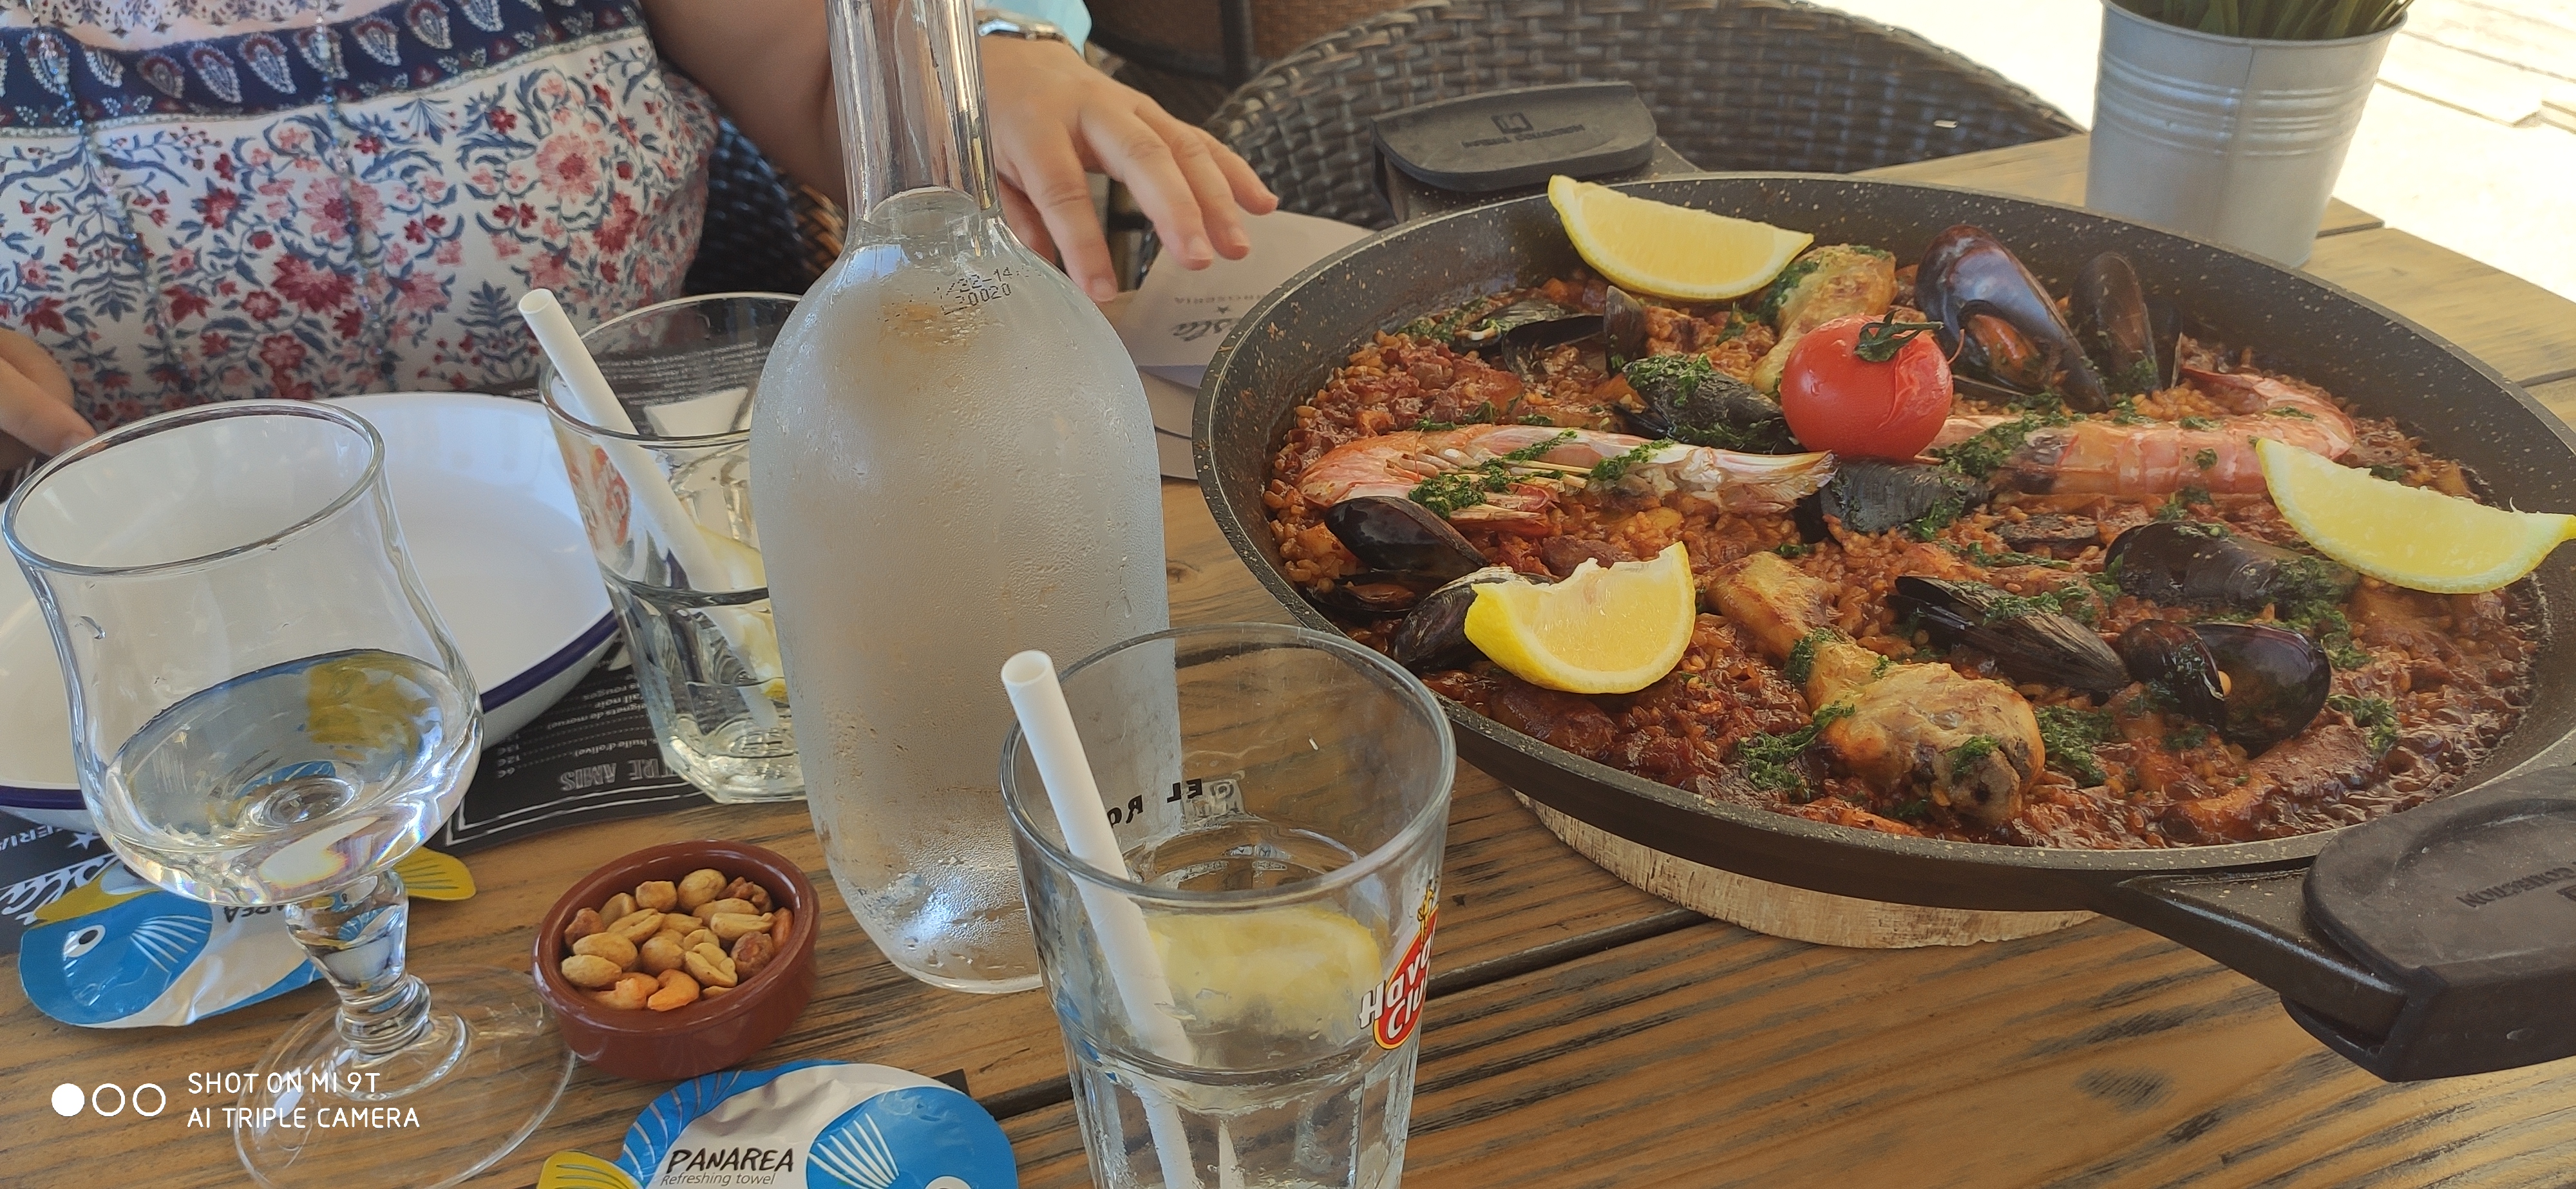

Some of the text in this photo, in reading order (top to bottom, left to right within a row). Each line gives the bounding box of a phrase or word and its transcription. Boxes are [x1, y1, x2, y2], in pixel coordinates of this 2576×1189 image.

[559, 758, 679, 791] TRE AMIS
[1358, 932, 1433, 1029] Hava
[1387, 969, 1428, 1040] Clu
[666, 1146, 794, 1174] PANAREA
[660, 1172, 776, 1186] Refreshing towel
